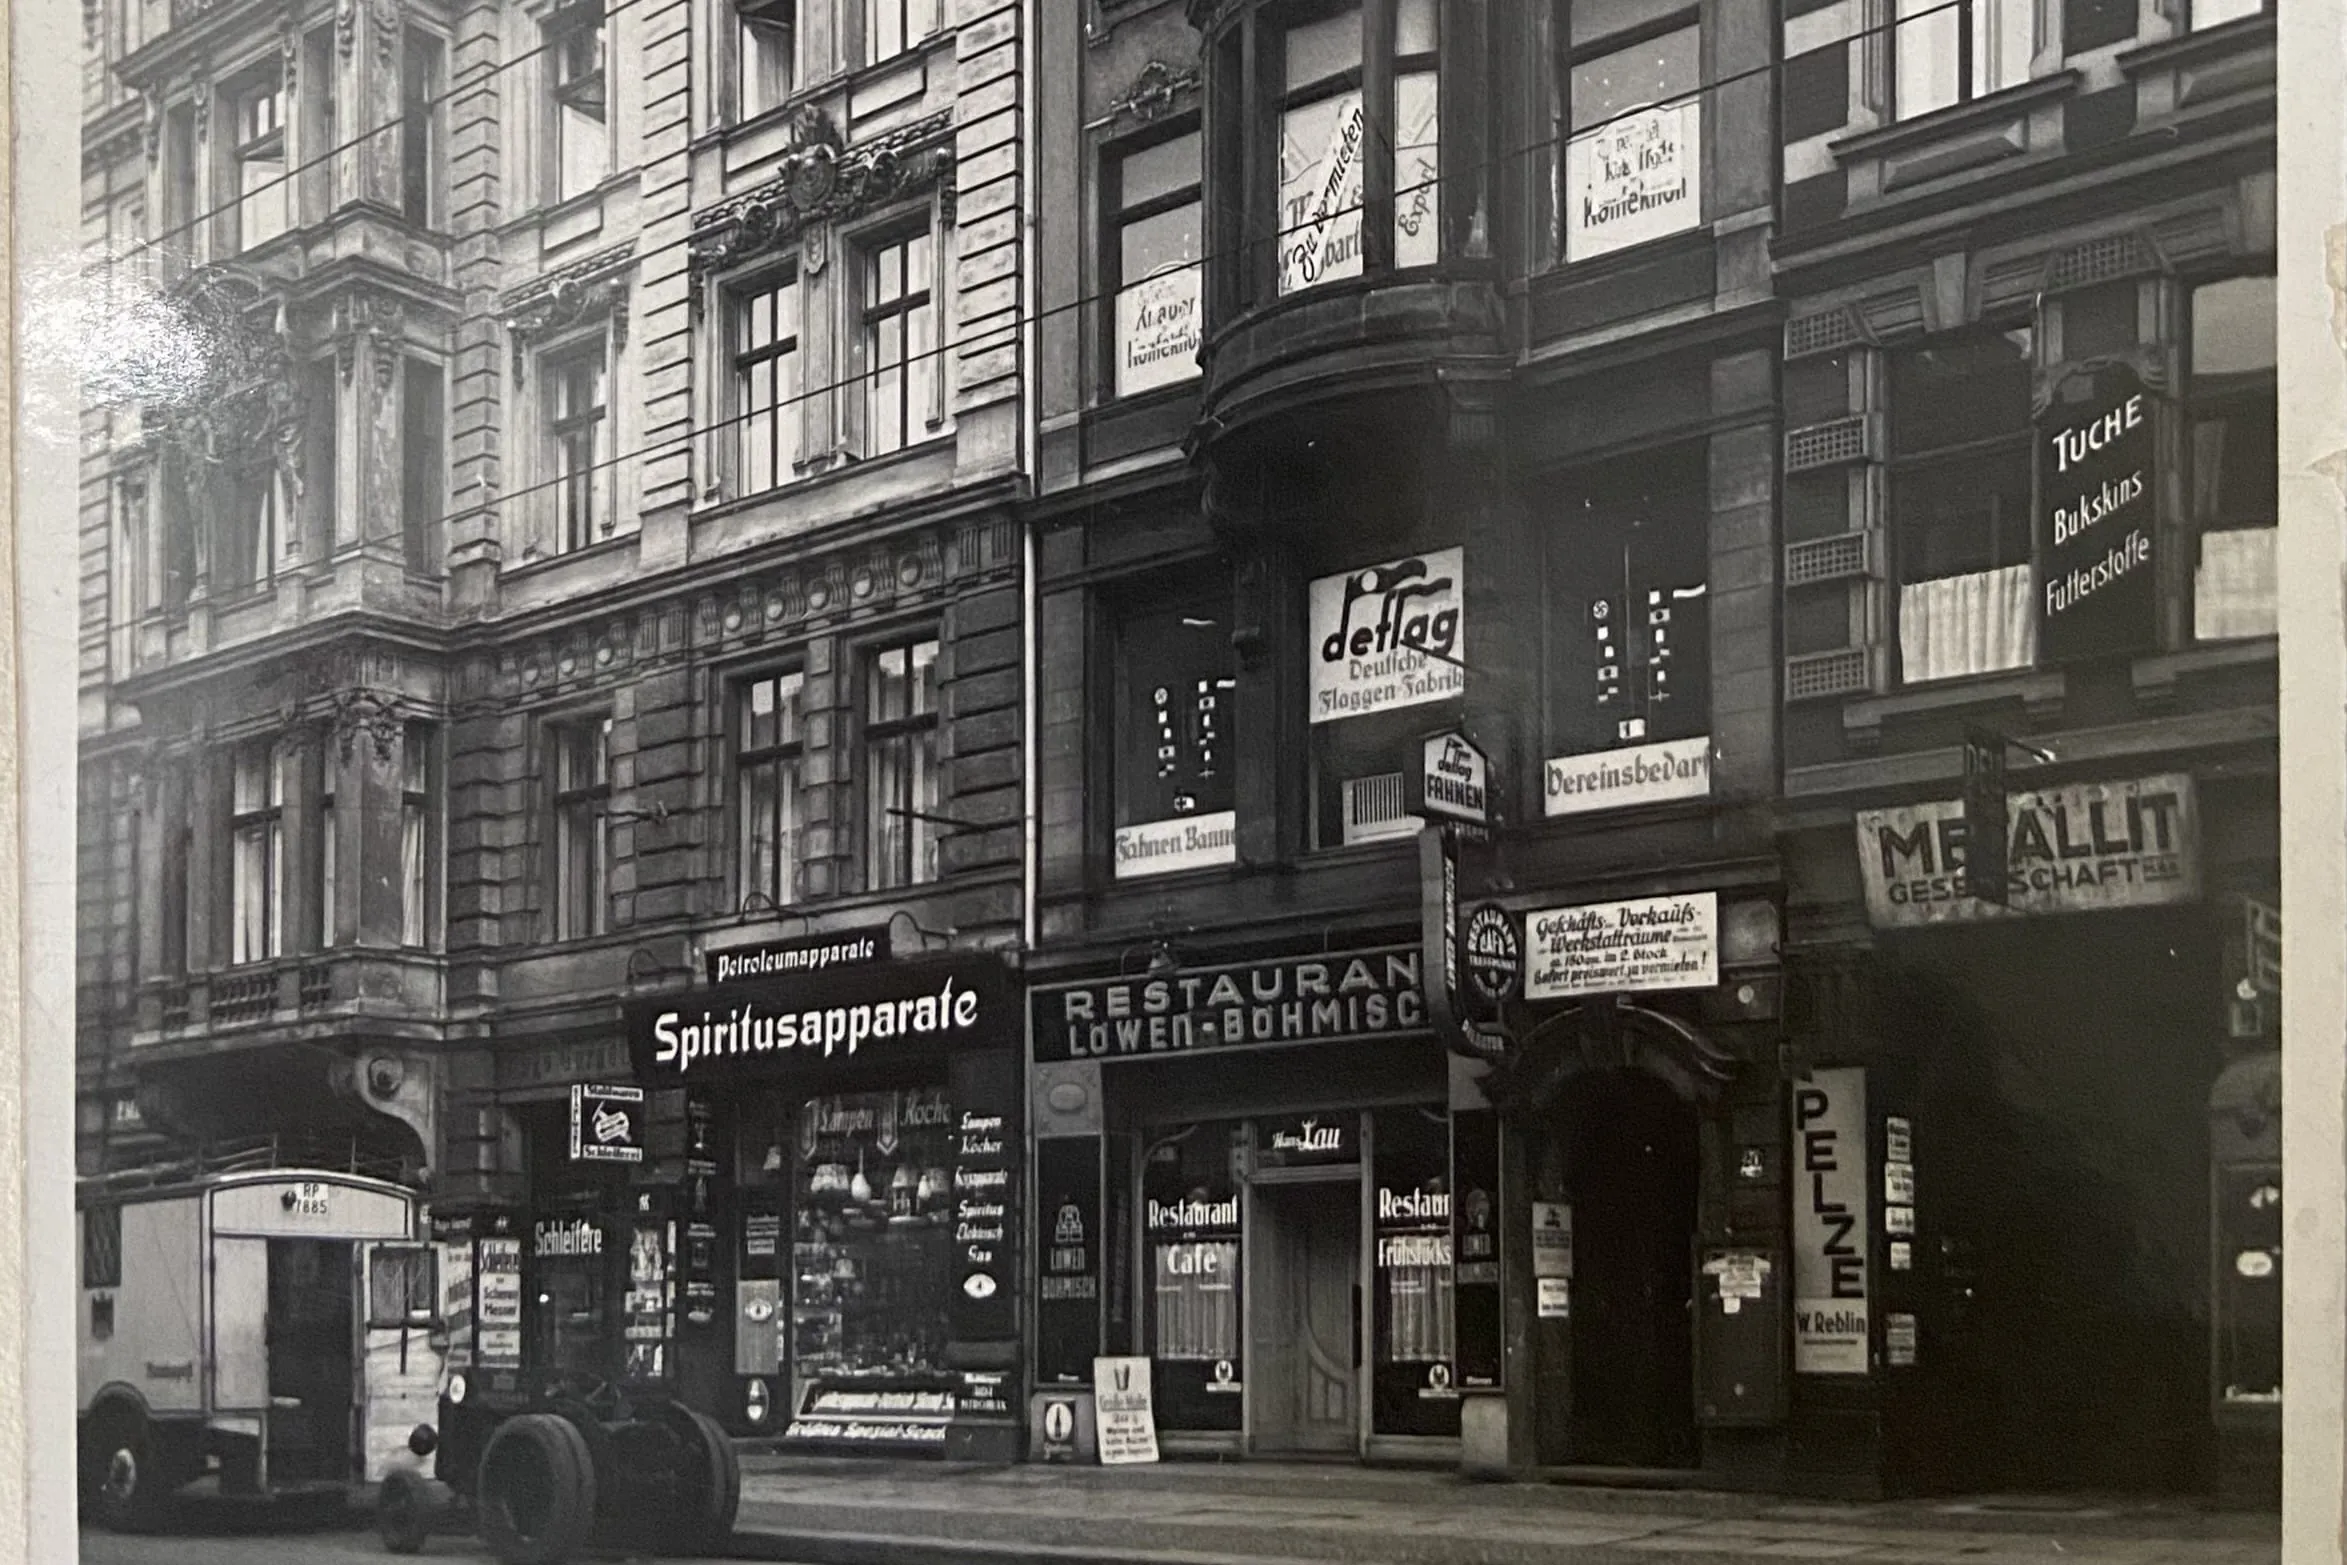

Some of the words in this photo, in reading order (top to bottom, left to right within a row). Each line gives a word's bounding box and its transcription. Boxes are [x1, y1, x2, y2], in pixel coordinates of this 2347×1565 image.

[2052, 393, 2143, 472] TUCHE
[2054, 469, 2143, 546] Bukskins
[2045, 528, 2150, 617] Futterstoffe
[1425, 773, 1484, 811] FAHNEN
[1878, 792, 2178, 879] MEALLIT
[718, 935, 875, 983] Petroleumapparate
[1064, 951, 1420, 1022] RESTAURAN
[653, 975, 979, 1073] Spiritusapparate
[1148, 1194, 1239, 1229] Restaurant
[1379, 1186, 1451, 1220] Restaur
[1795, 1088, 1865, 1300] PELZE
